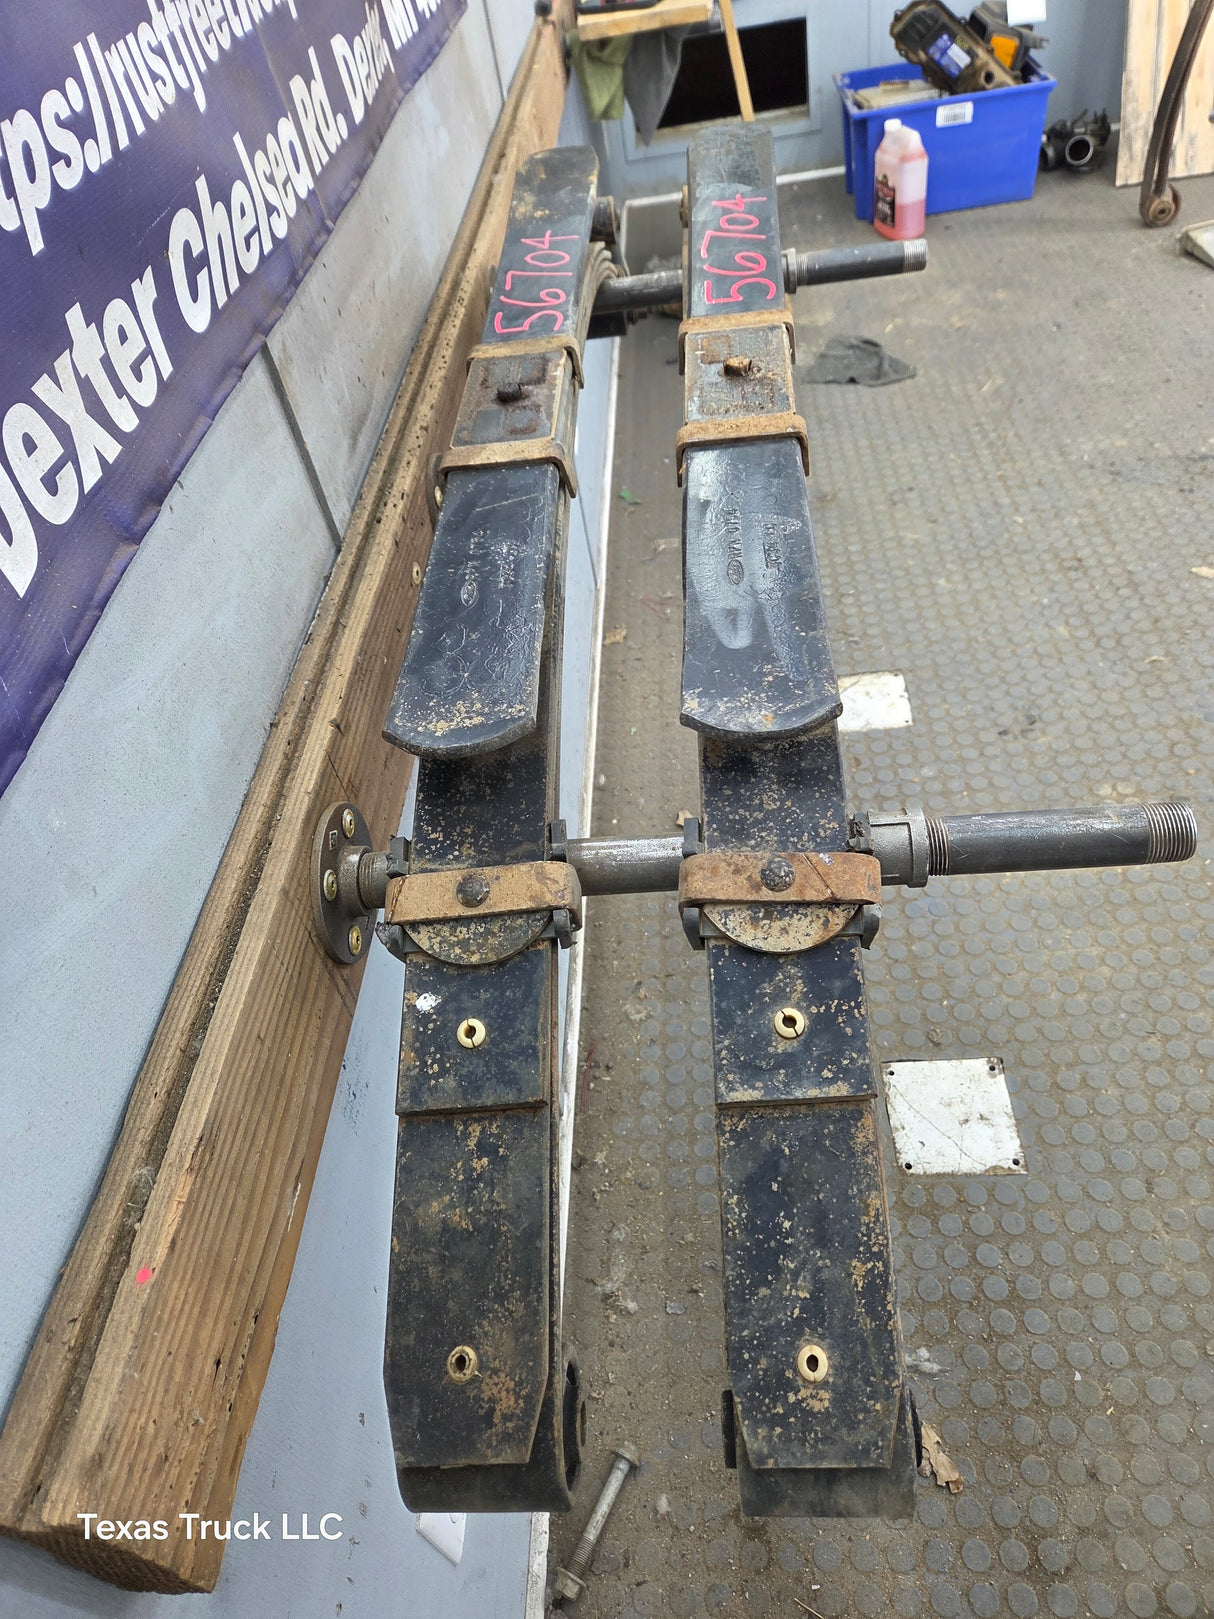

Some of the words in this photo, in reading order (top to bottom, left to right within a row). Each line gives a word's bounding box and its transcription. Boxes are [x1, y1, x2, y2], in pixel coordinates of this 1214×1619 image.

[169, 110, 315, 333] Chelsea
[289, 45, 348, 176] Rd.
[494, 230, 580, 334] 56704
[701, 193, 777, 305] 56704
